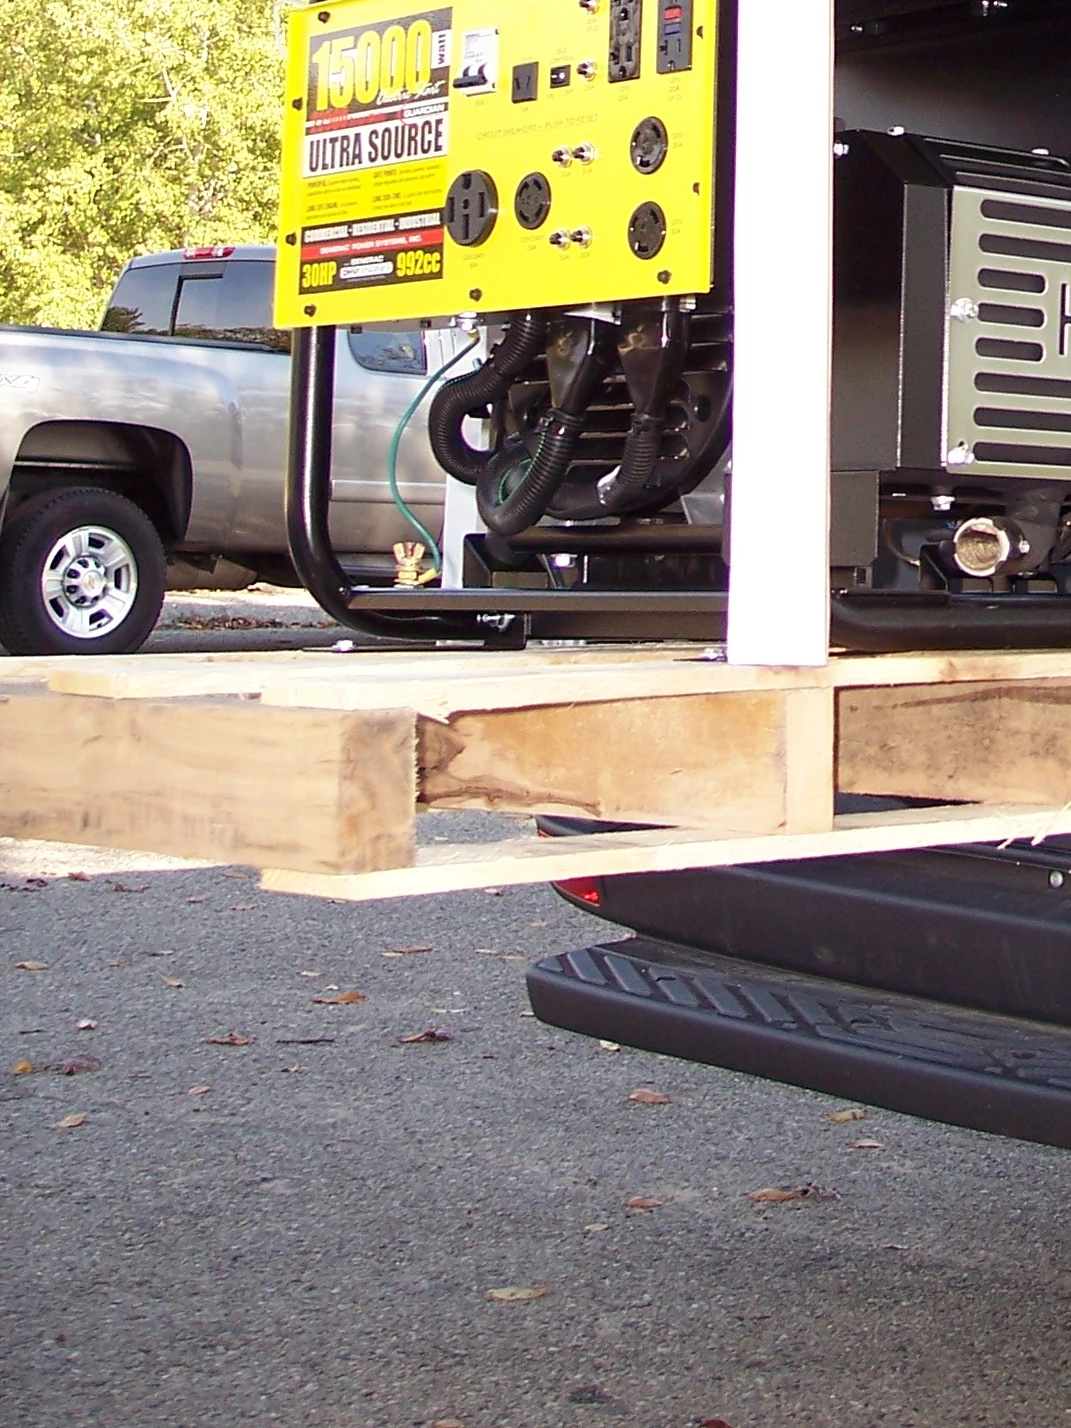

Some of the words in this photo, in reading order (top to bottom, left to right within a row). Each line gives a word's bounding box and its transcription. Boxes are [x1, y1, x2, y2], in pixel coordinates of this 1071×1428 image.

[312, 18, 433, 111] 15000
[308, 132, 363, 173] ULTRA
[367, 118, 444, 163] SOURCE
[302, 261, 337, 288] 30HP
